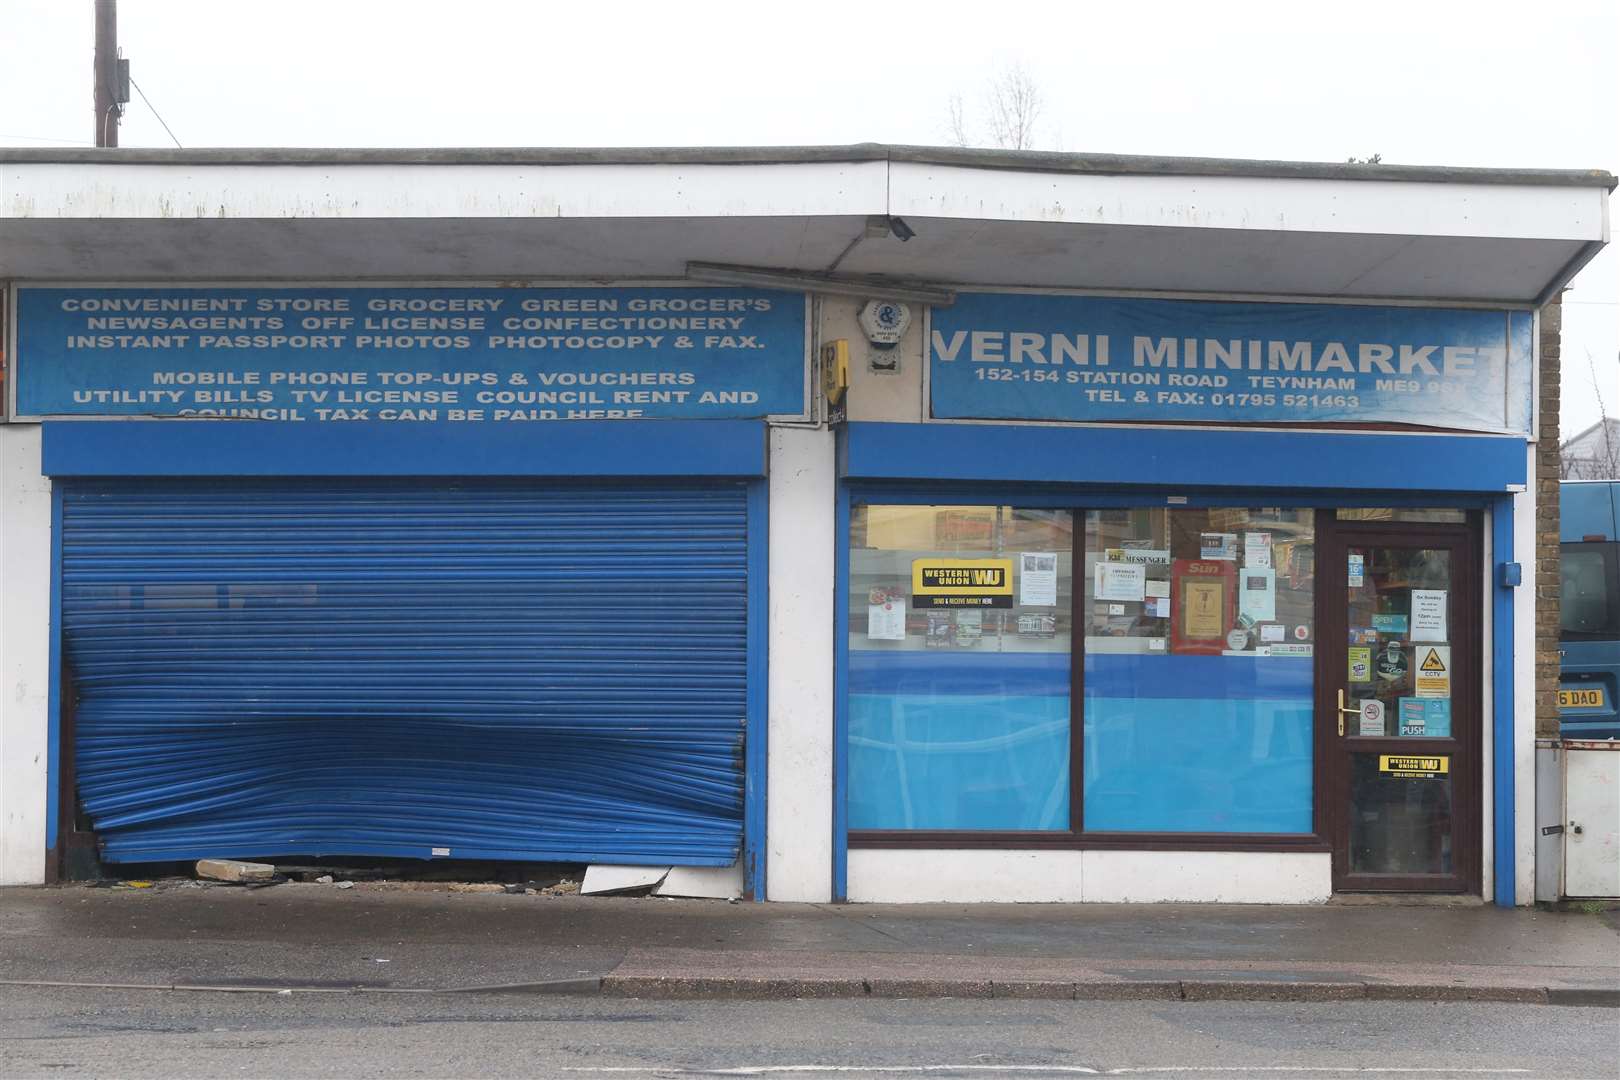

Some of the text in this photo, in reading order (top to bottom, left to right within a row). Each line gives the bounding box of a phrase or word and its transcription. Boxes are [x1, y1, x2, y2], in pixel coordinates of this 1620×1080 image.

[61, 298, 771, 312] CONVENIENT STORE GROCERY GREEN GROCER'S
[87, 316, 745, 331] NEWSAGENTS OFF LICENSE CONFECTIONERY
[67, 335, 766, 349] INSTANT PASSPORT PHOTOS PHOTOCOPY & FAX.
[931, 329, 1506, 379] VERNI MINIMARKET
[153, 371, 696, 386] MOBILE PHONE TOP-UPS & VOUCHERS
[975, 367, 1060, 383] 152-154
[1065, 370, 1161, 386] STATION
[1168, 373, 1229, 388] ROAD
[1247, 375, 1356, 391] TEYNHAM
[1375, 378, 1420, 393] ME9
[73, 390, 759, 404] UTILITY BILLS TV LICENSE COUNCIL RENT AND
[1084, 389, 1360, 409] TEL & FAX: 01795 521463
[178, 408, 644, 421] COUNCIL TAX CAN BE PAID HERE
[1125, 555, 1167, 564] MESSENGER
[924, 569, 970, 578] WESTERN
[1188, 562, 1219, 574] Sun
[938, 577, 970, 585] UNION
[1570, 691, 1598, 705] DAO
[1401, 726, 1425, 735] PUSH
